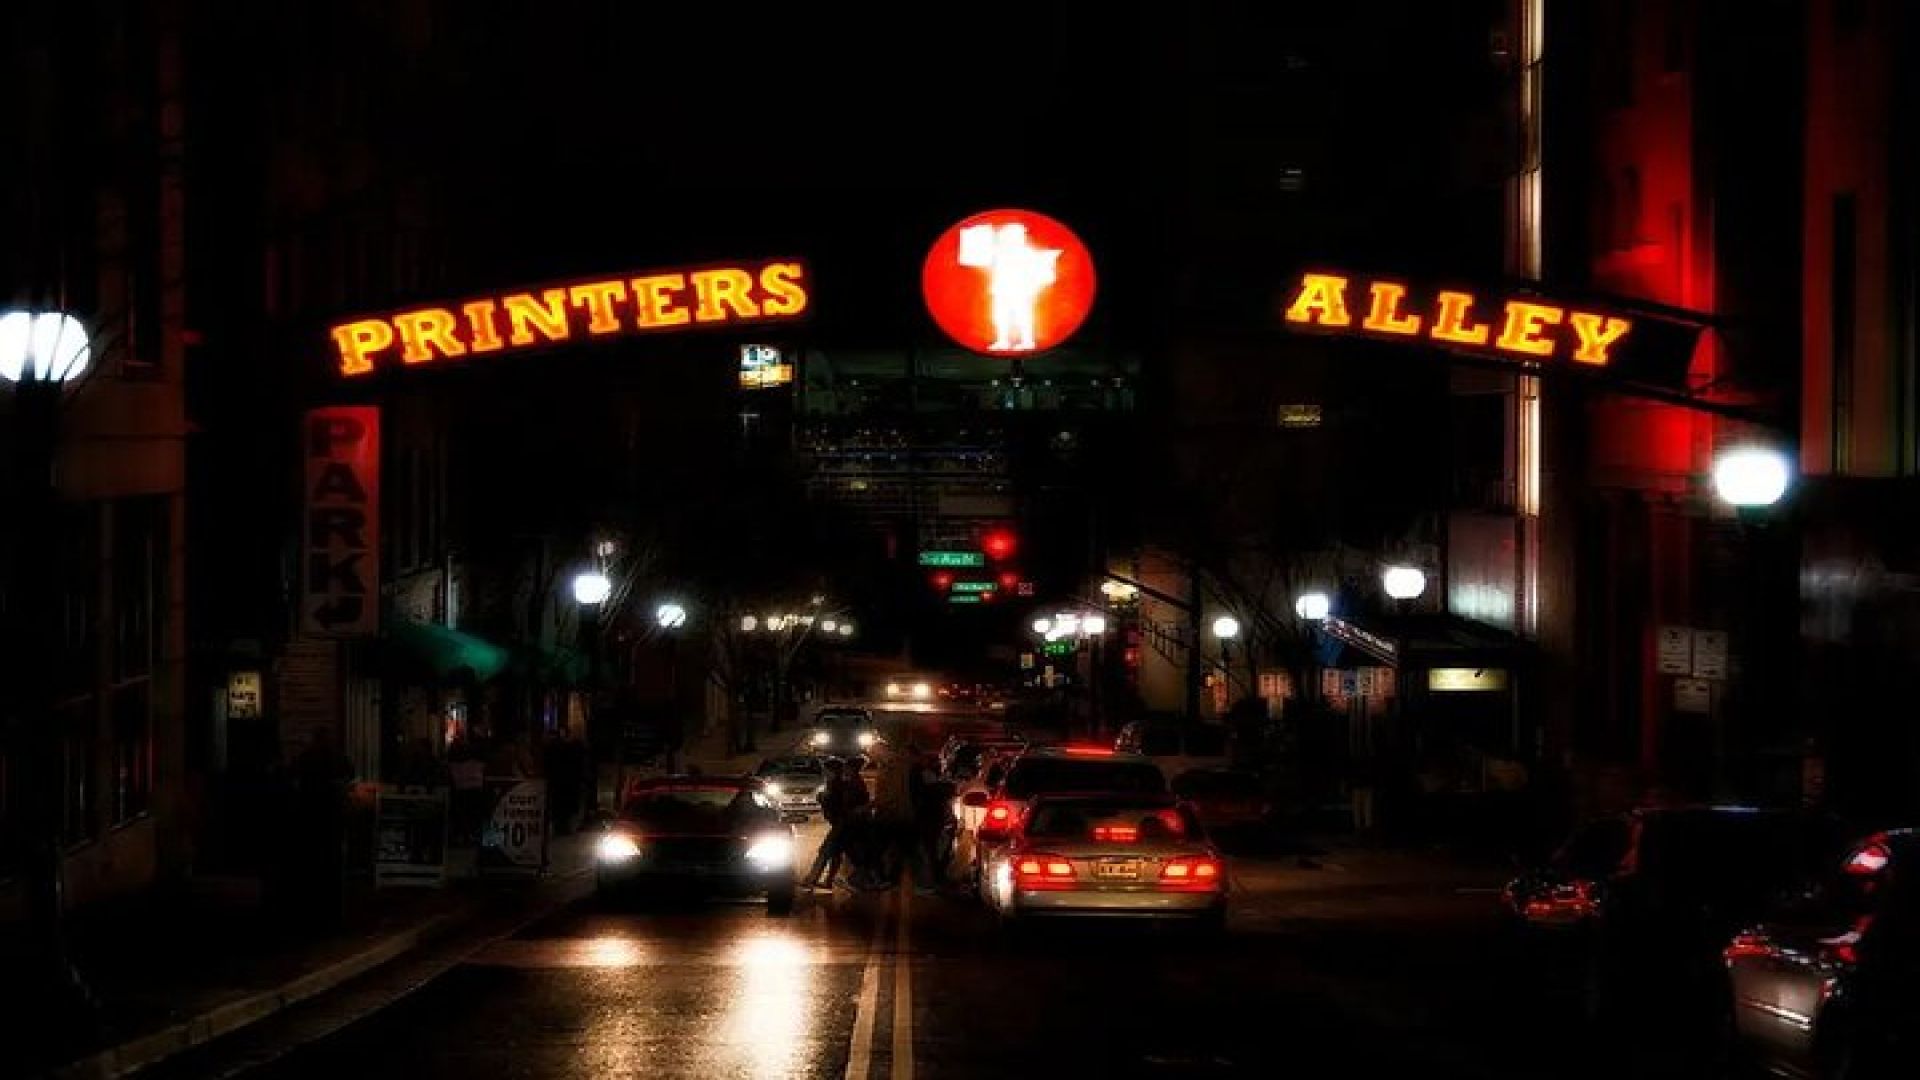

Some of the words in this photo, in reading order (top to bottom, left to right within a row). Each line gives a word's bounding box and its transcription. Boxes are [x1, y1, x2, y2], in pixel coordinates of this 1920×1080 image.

[331, 262, 807, 376] PRINTERS
[1285, 273, 1632, 366] ALLEY
[311, 414, 368, 594] PARK
